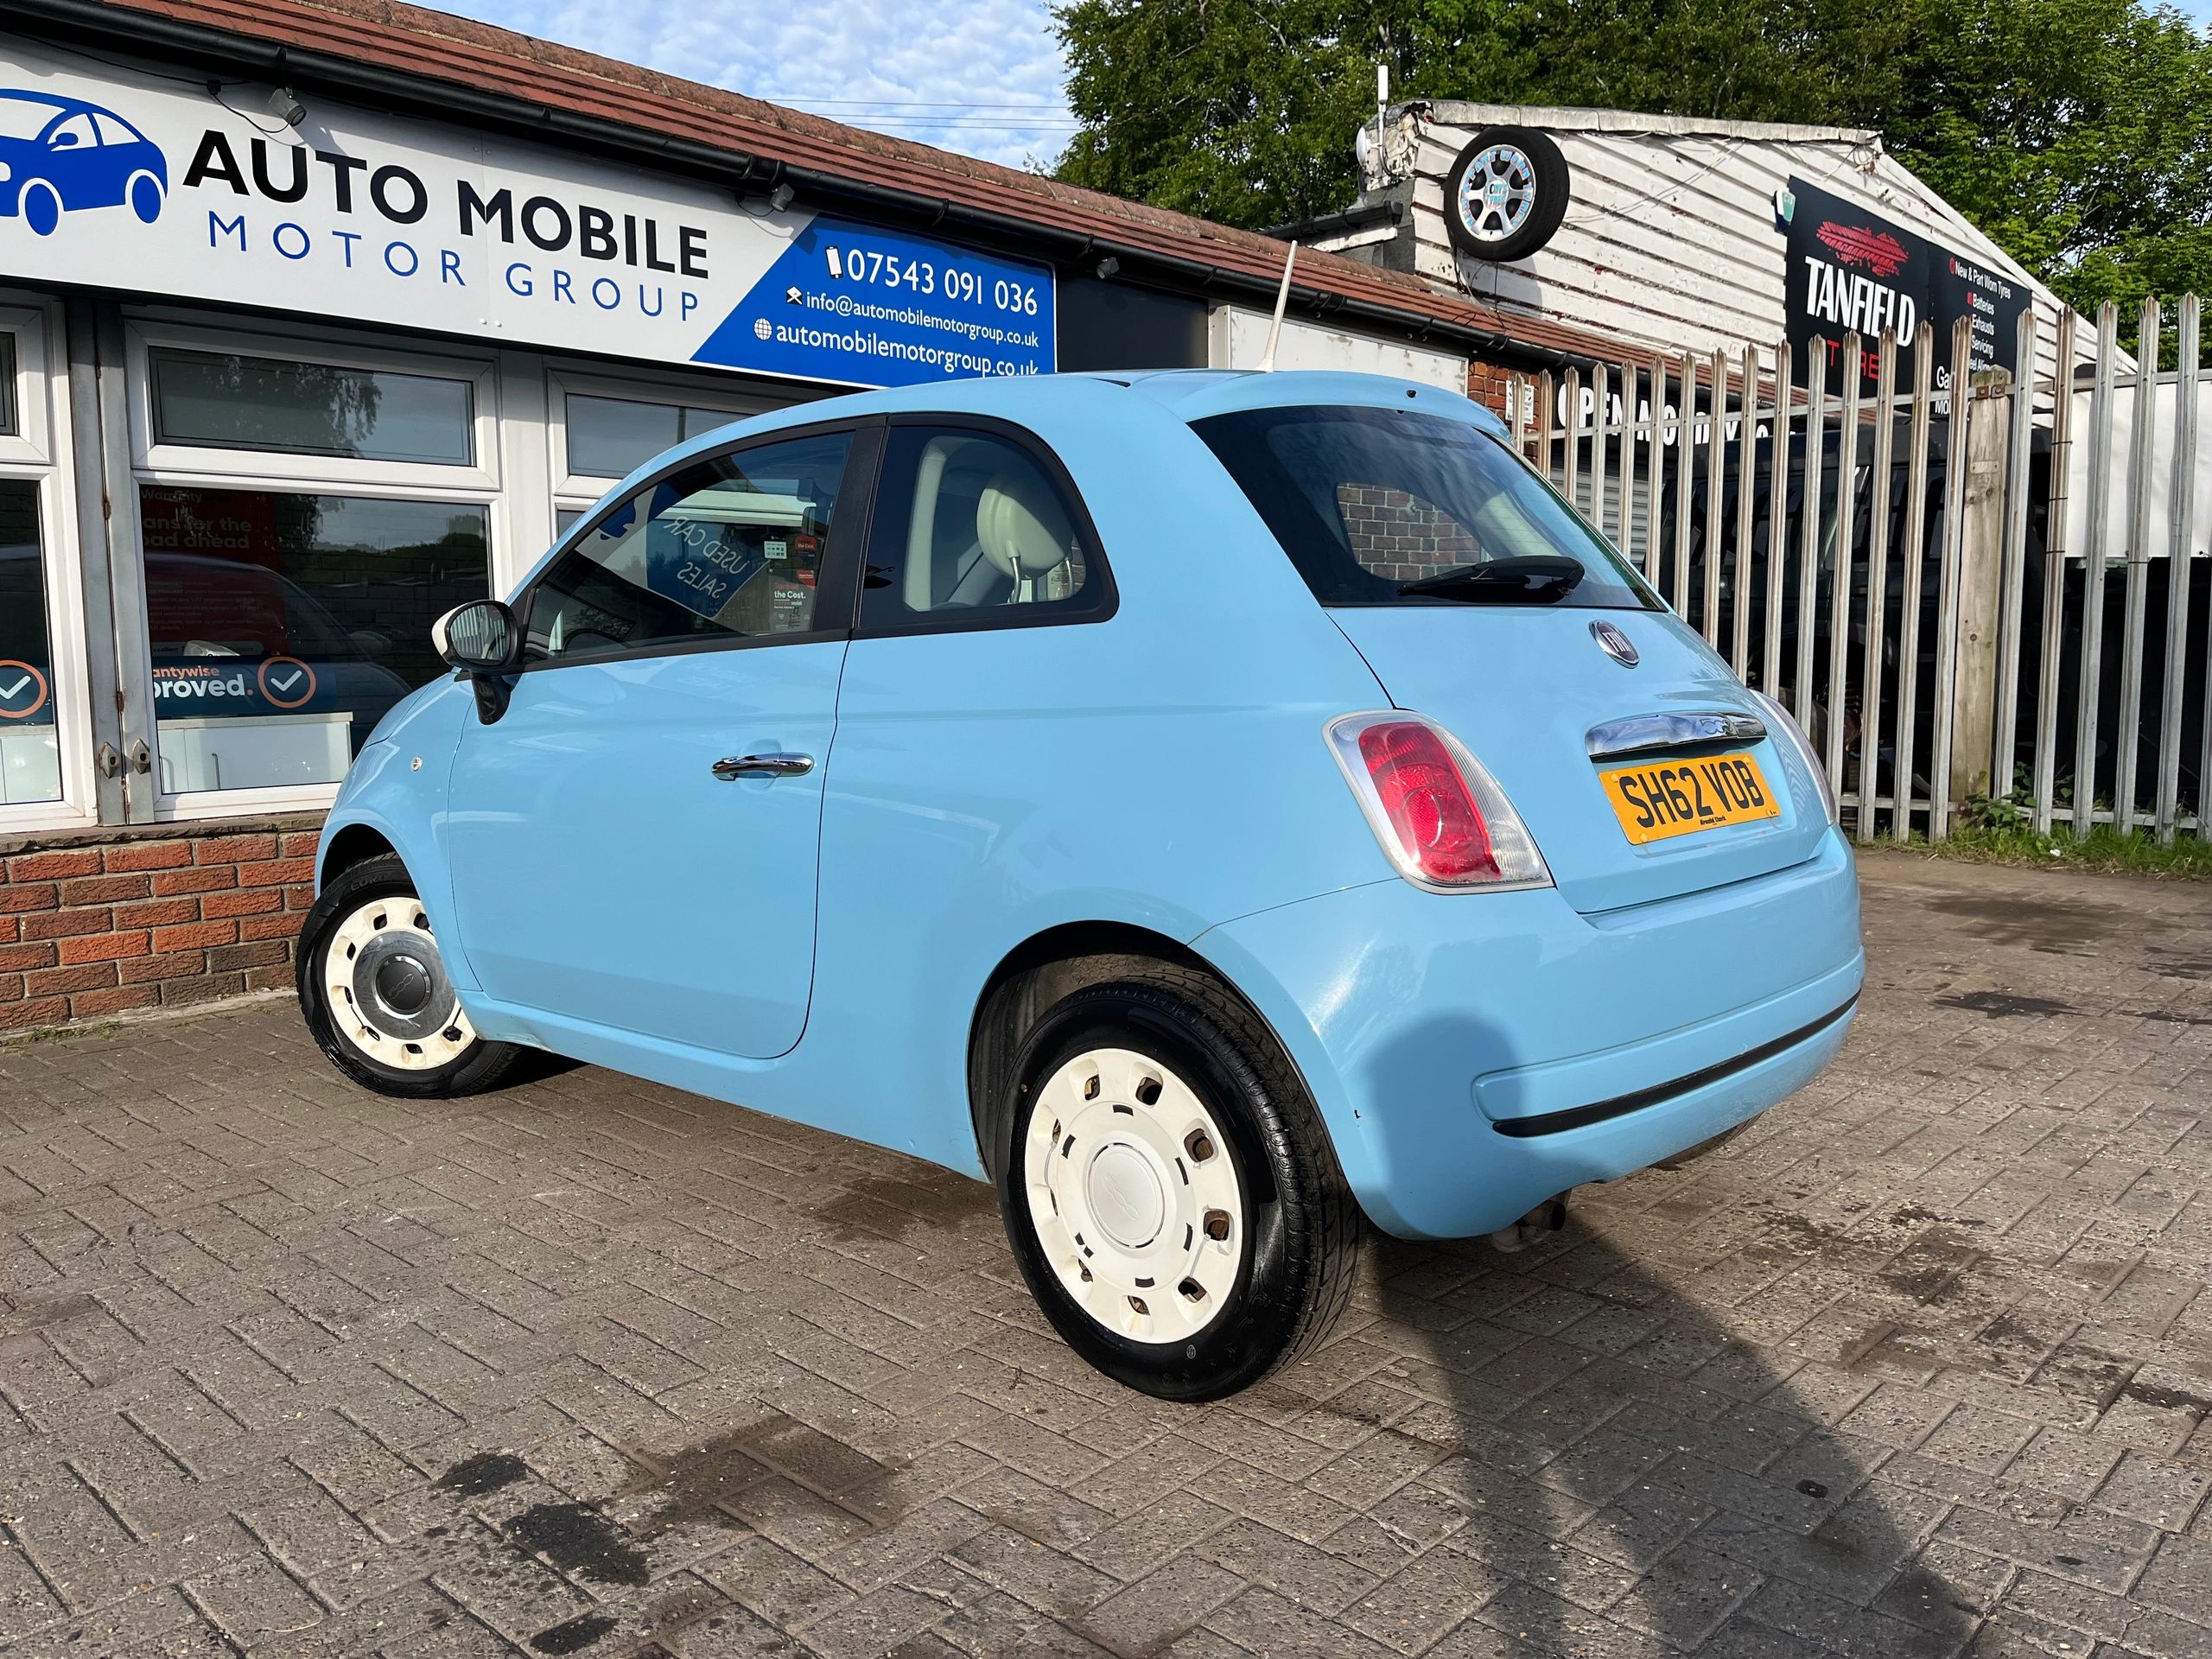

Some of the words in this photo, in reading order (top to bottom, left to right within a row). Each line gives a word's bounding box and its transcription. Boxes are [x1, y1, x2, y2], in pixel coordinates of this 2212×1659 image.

[182, 130, 428, 225] AUTO
[457, 180, 709, 279] MOBILE
[209, 211, 466, 286] MOTOR
[505, 263, 698, 322] GROUP
[848, 249, 934, 295] 07543
[944, 269, 982, 304] 091
[995, 280, 1037, 315] 036
[1955, 261, 1967, 279] New
[1968, 267, 1973, 282] &
[1974, 269, 1984, 287] Part
[1984, 274, 1997, 294] Worn
[1998, 281, 2011, 299] Tyres
[806, 292, 1039, 348] info@automobilemotorgroup.co.uk
[1805, 256, 1916, 347] TANFIELD
[1972, 314, 1994, 335] Exhausts
[1973, 293, 1994, 315] Batteries
[777, 323, 1039, 377] automobilemotorgroup.co.uk
[1972, 335, 1993, 359] Servicing
[219, 517, 251, 532] the
[774, 590, 786, 599] the
[787, 590, 806, 599] Cost.
[1618, 767, 1713, 827] SH62
[1700, 760, 1764, 812] VOB
